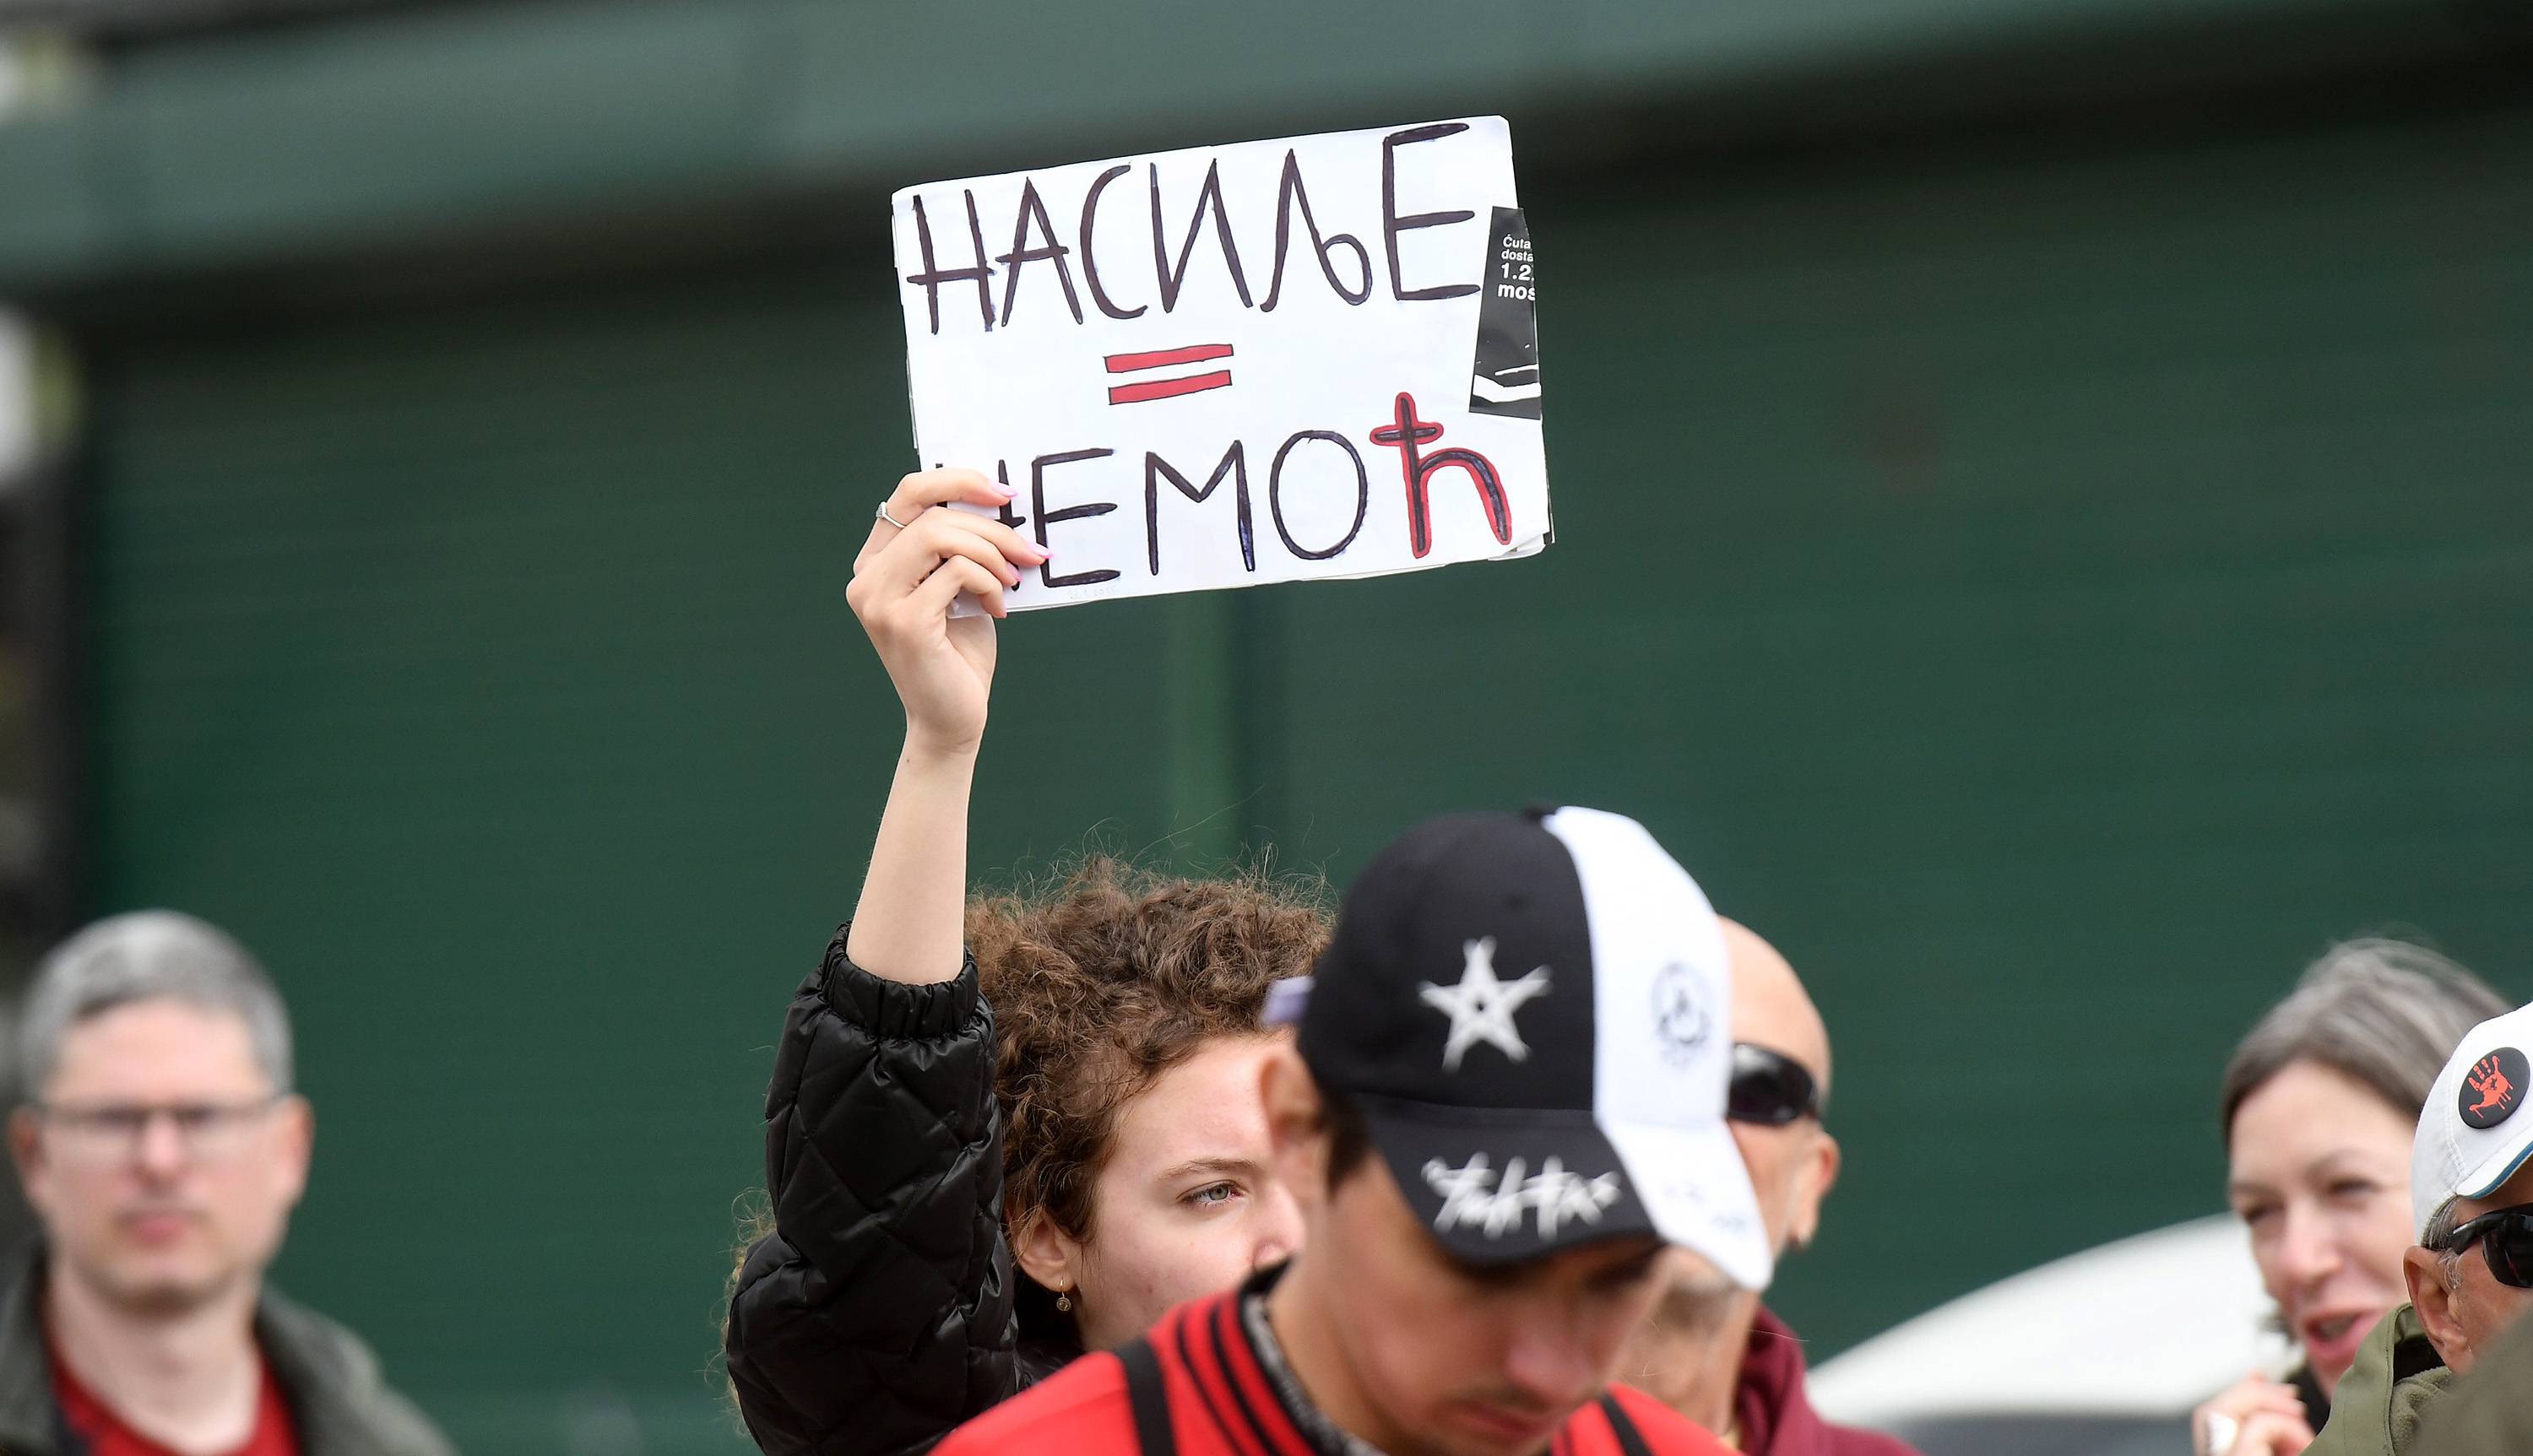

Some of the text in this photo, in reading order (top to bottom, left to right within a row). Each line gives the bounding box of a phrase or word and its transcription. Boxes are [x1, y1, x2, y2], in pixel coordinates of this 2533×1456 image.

[906, 122, 1481, 335] НАСИЉЕ
[1502, 233, 1532, 250] Ćuta
[1500, 248, 1534, 263] dosta
